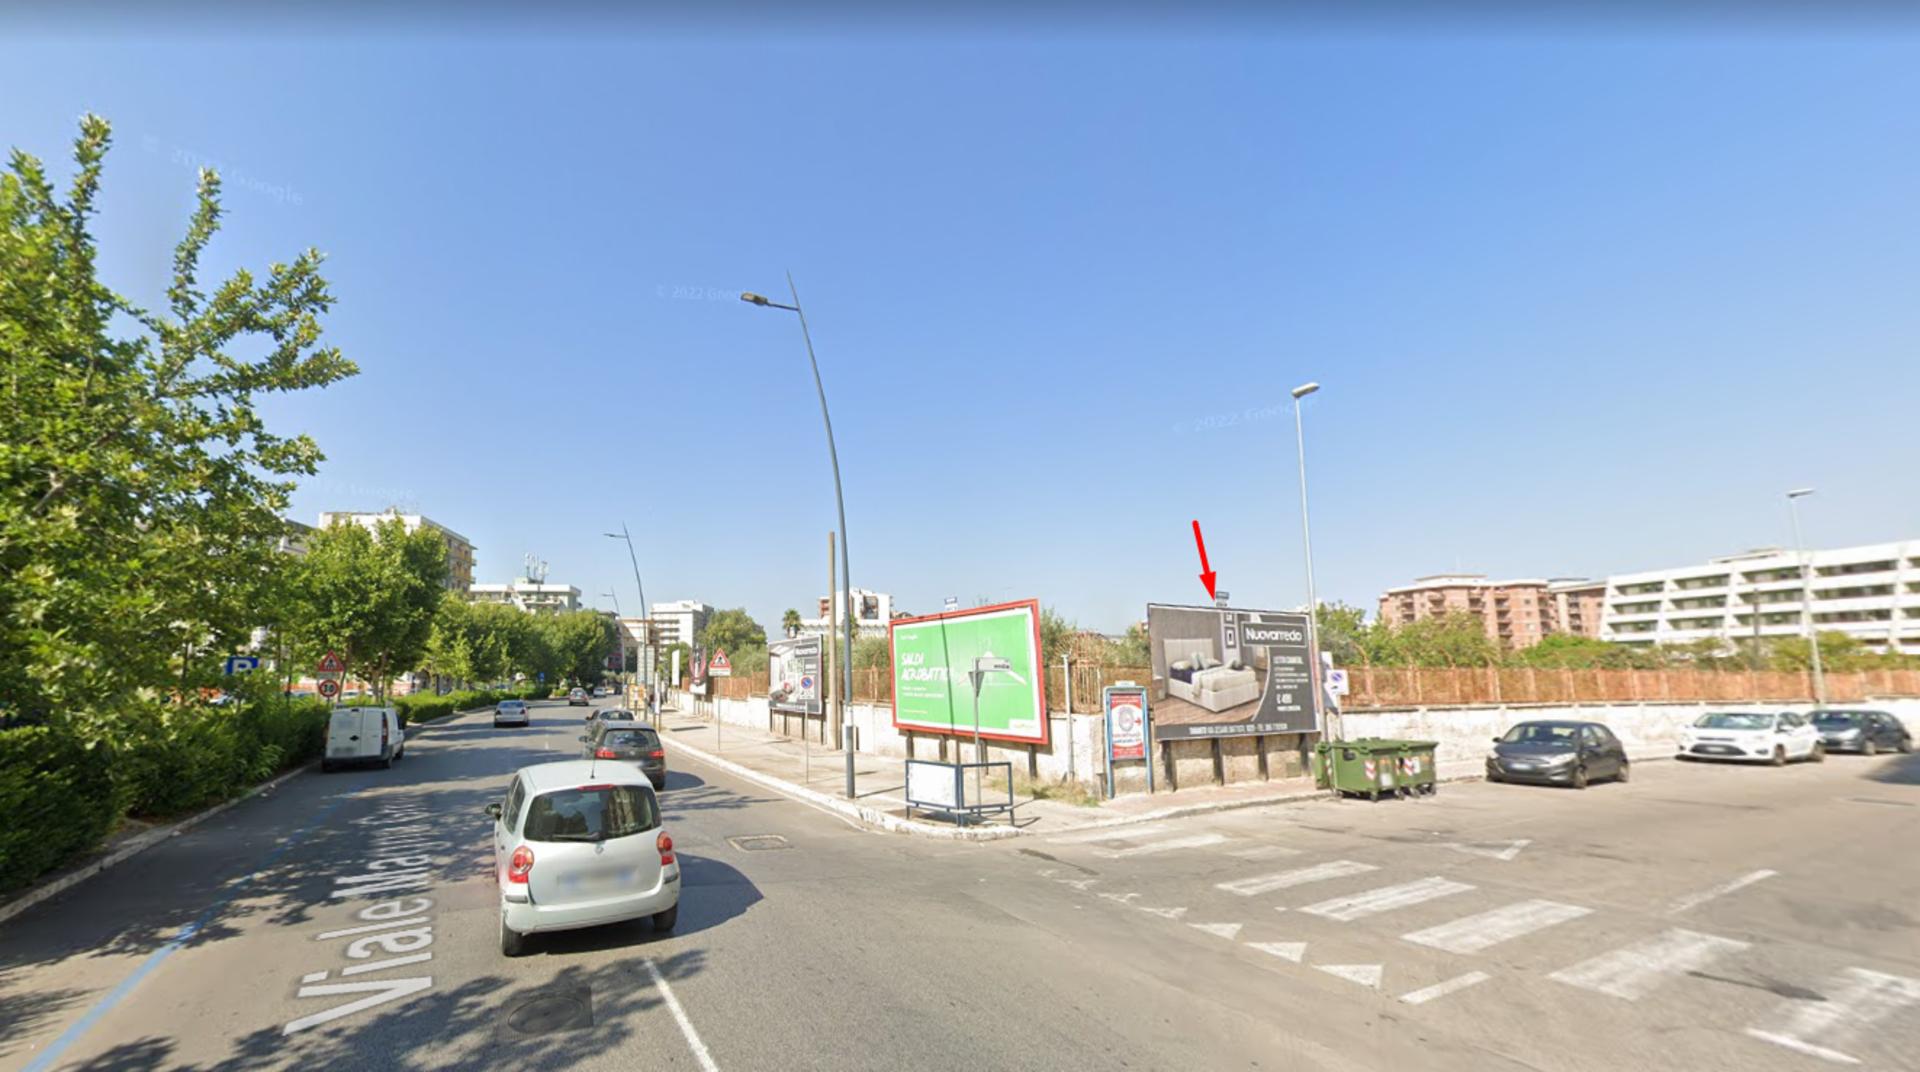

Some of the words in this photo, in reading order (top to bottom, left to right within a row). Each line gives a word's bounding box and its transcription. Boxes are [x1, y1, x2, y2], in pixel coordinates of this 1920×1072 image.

[1244, 626, 1303, 642] Nuovarredo
[232, 658, 252, 676] P
[901, 651, 924, 667] SALDI
